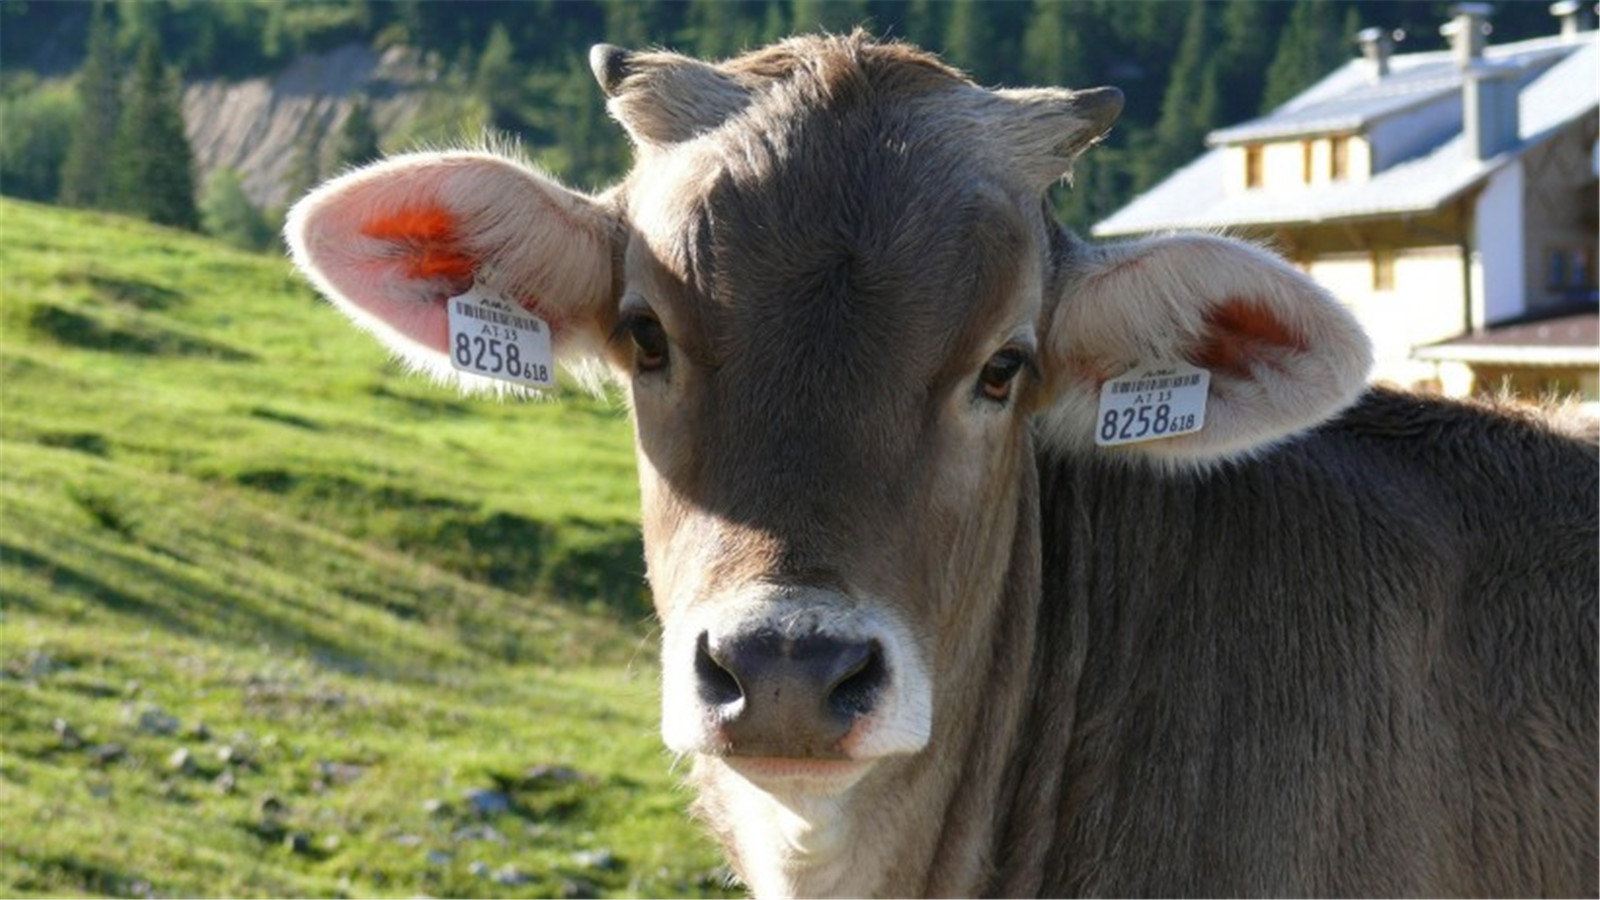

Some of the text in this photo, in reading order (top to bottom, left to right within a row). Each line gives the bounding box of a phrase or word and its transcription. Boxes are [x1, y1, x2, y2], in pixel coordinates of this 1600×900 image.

[481, 324, 498, 337] AT
[456, 332, 548, 382] 8258 618
[1101, 404, 1194, 441] 8258 618
